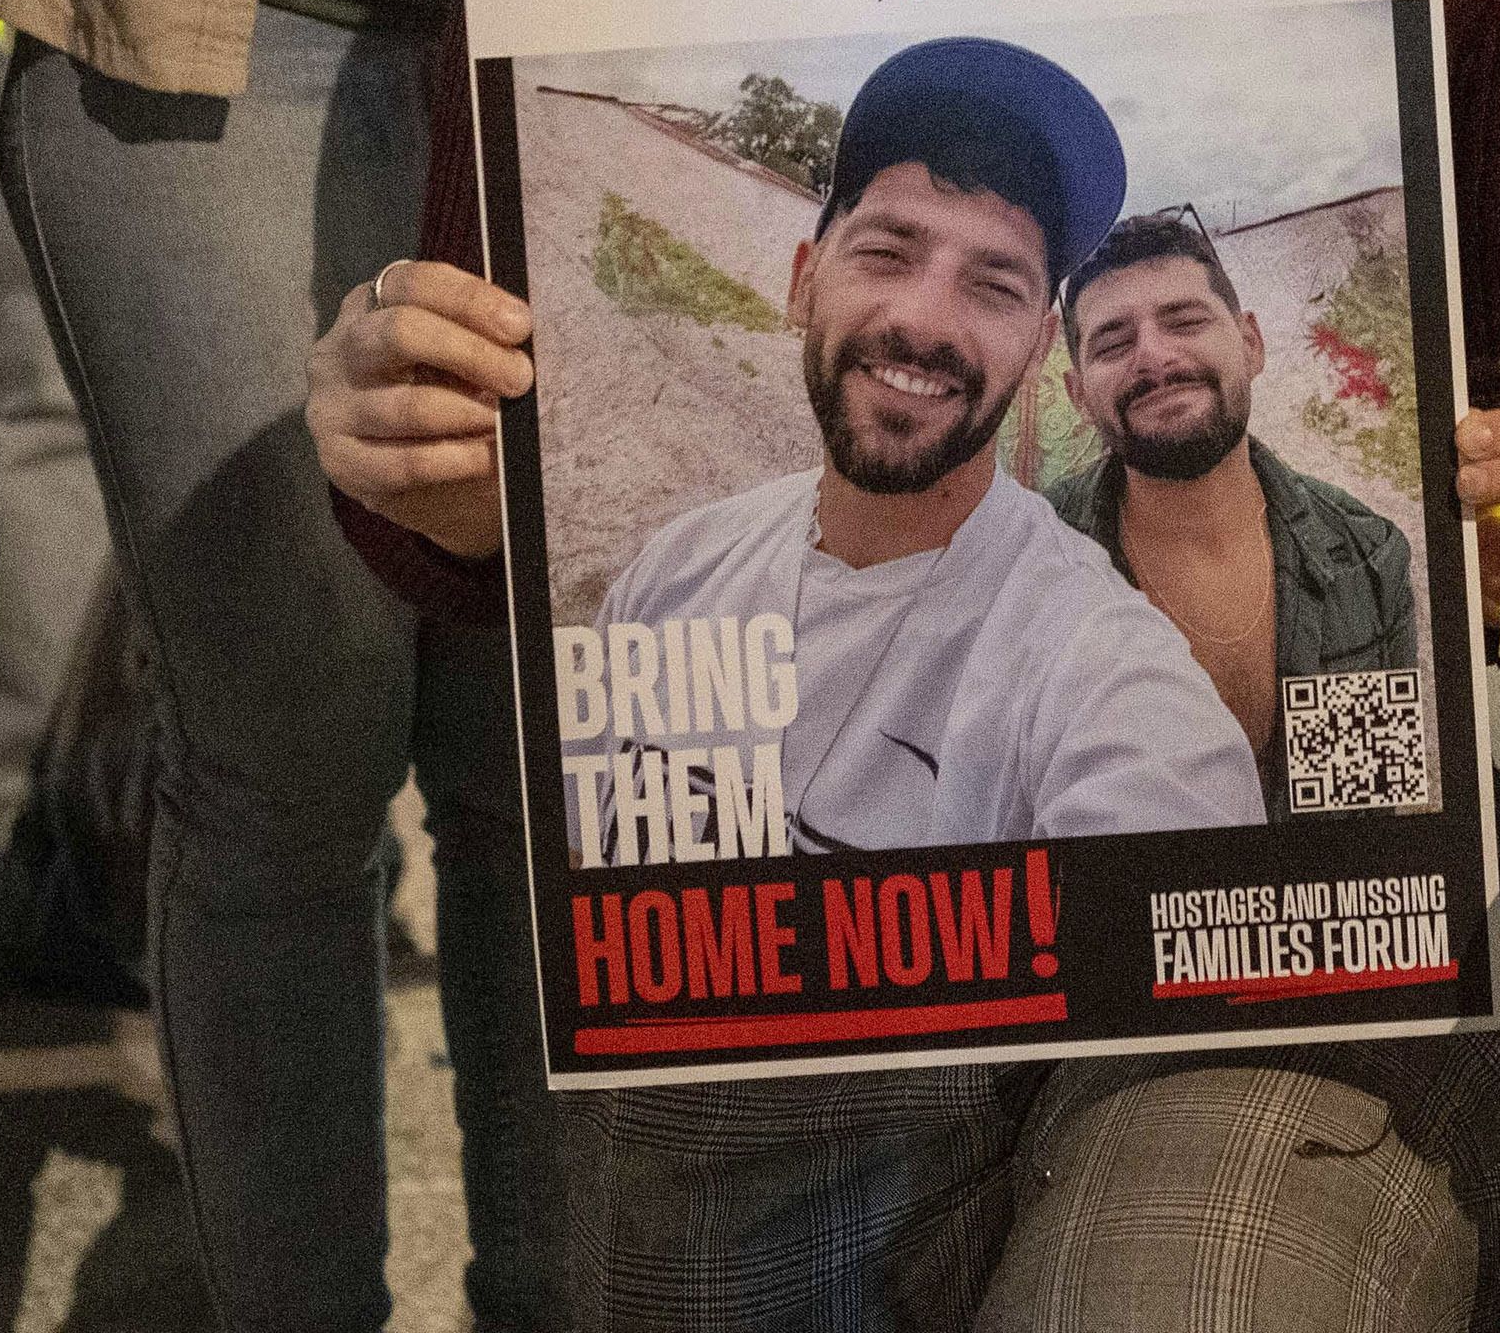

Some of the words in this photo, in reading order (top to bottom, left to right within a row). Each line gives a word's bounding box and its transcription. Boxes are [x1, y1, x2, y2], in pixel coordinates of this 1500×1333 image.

[555, 614, 797, 739] BRING
[561, 745, 790, 868] THEM
[573, 883, 801, 1006] HOME
[824, 850, 1058, 989] NOW!
[1151, 886, 1276, 929] HOSTAGES
[1283, 883, 1331, 920] AND
[1337, 875, 1446, 917] MISSING
[1154, 923, 1314, 985] FAMILIES
[1323, 914, 1449, 974] FORUM
